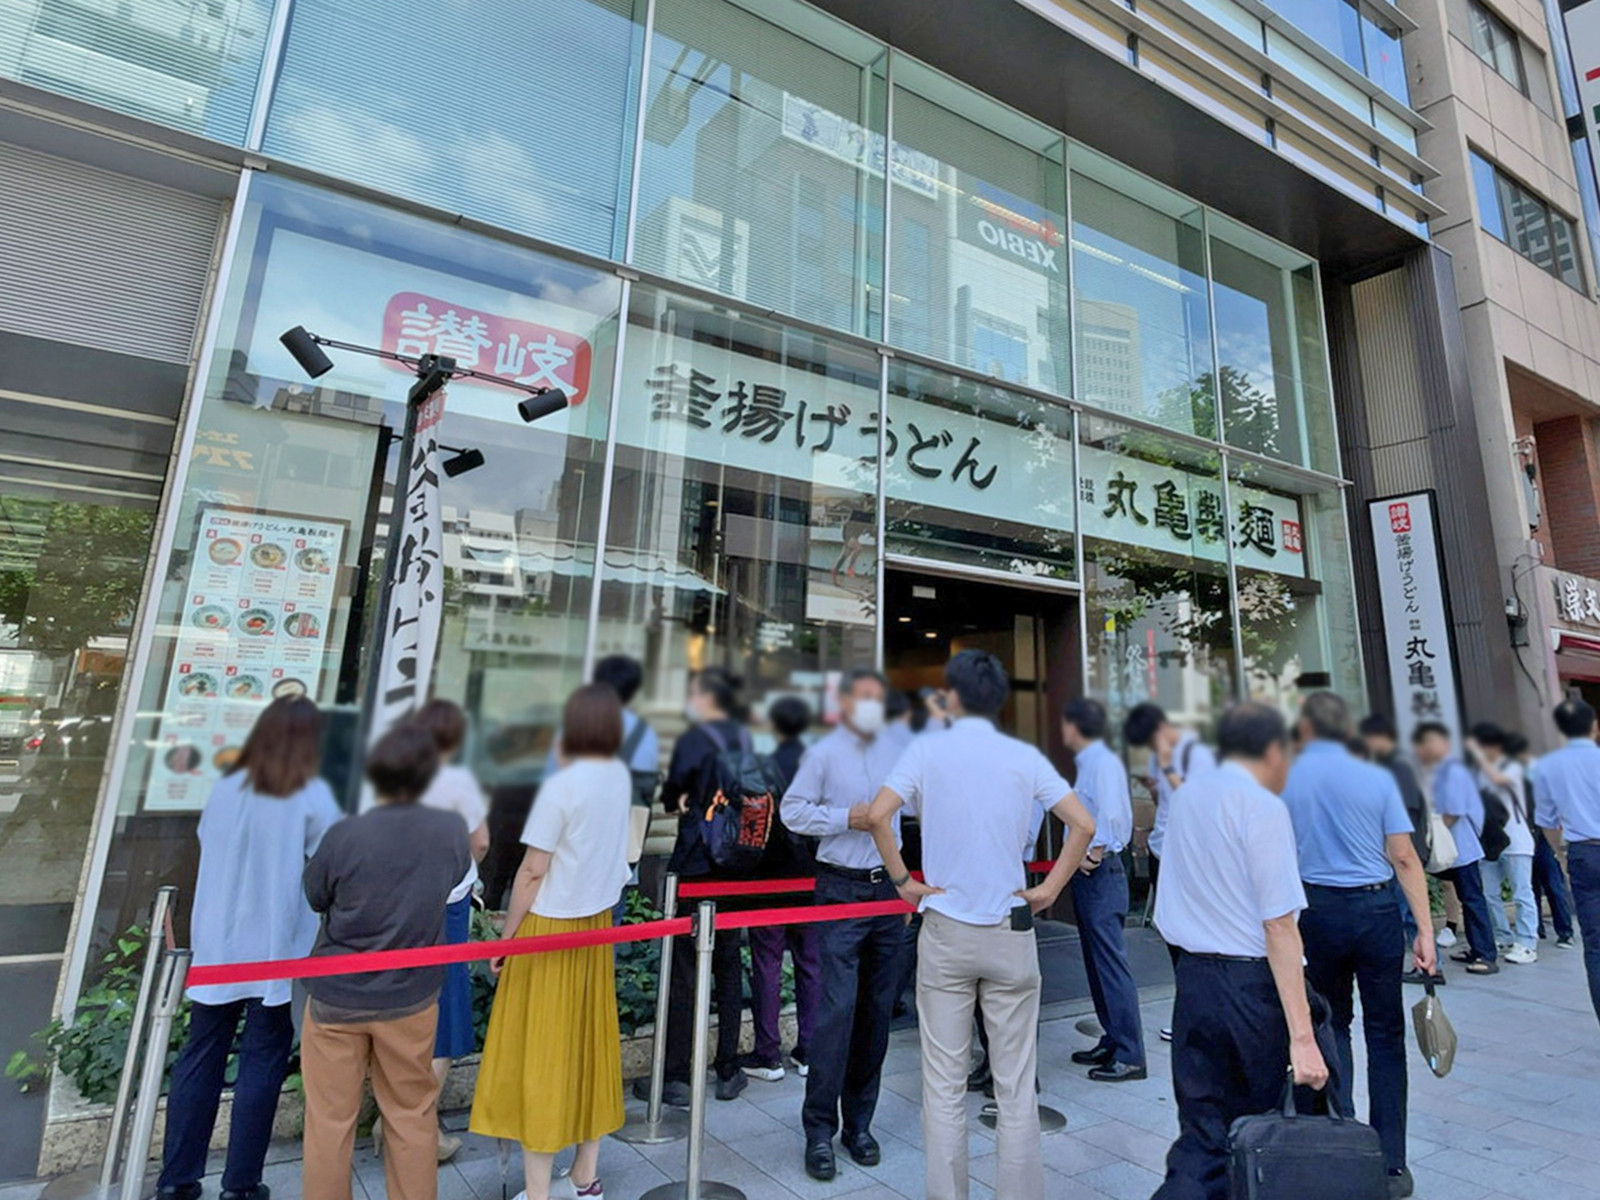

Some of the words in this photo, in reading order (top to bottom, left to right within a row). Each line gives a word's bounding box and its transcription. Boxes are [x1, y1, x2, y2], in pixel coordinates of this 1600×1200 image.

[646, 362, 998, 492] 釜揚げうどん
[1103, 470, 1278, 558] 丸亀製麺
